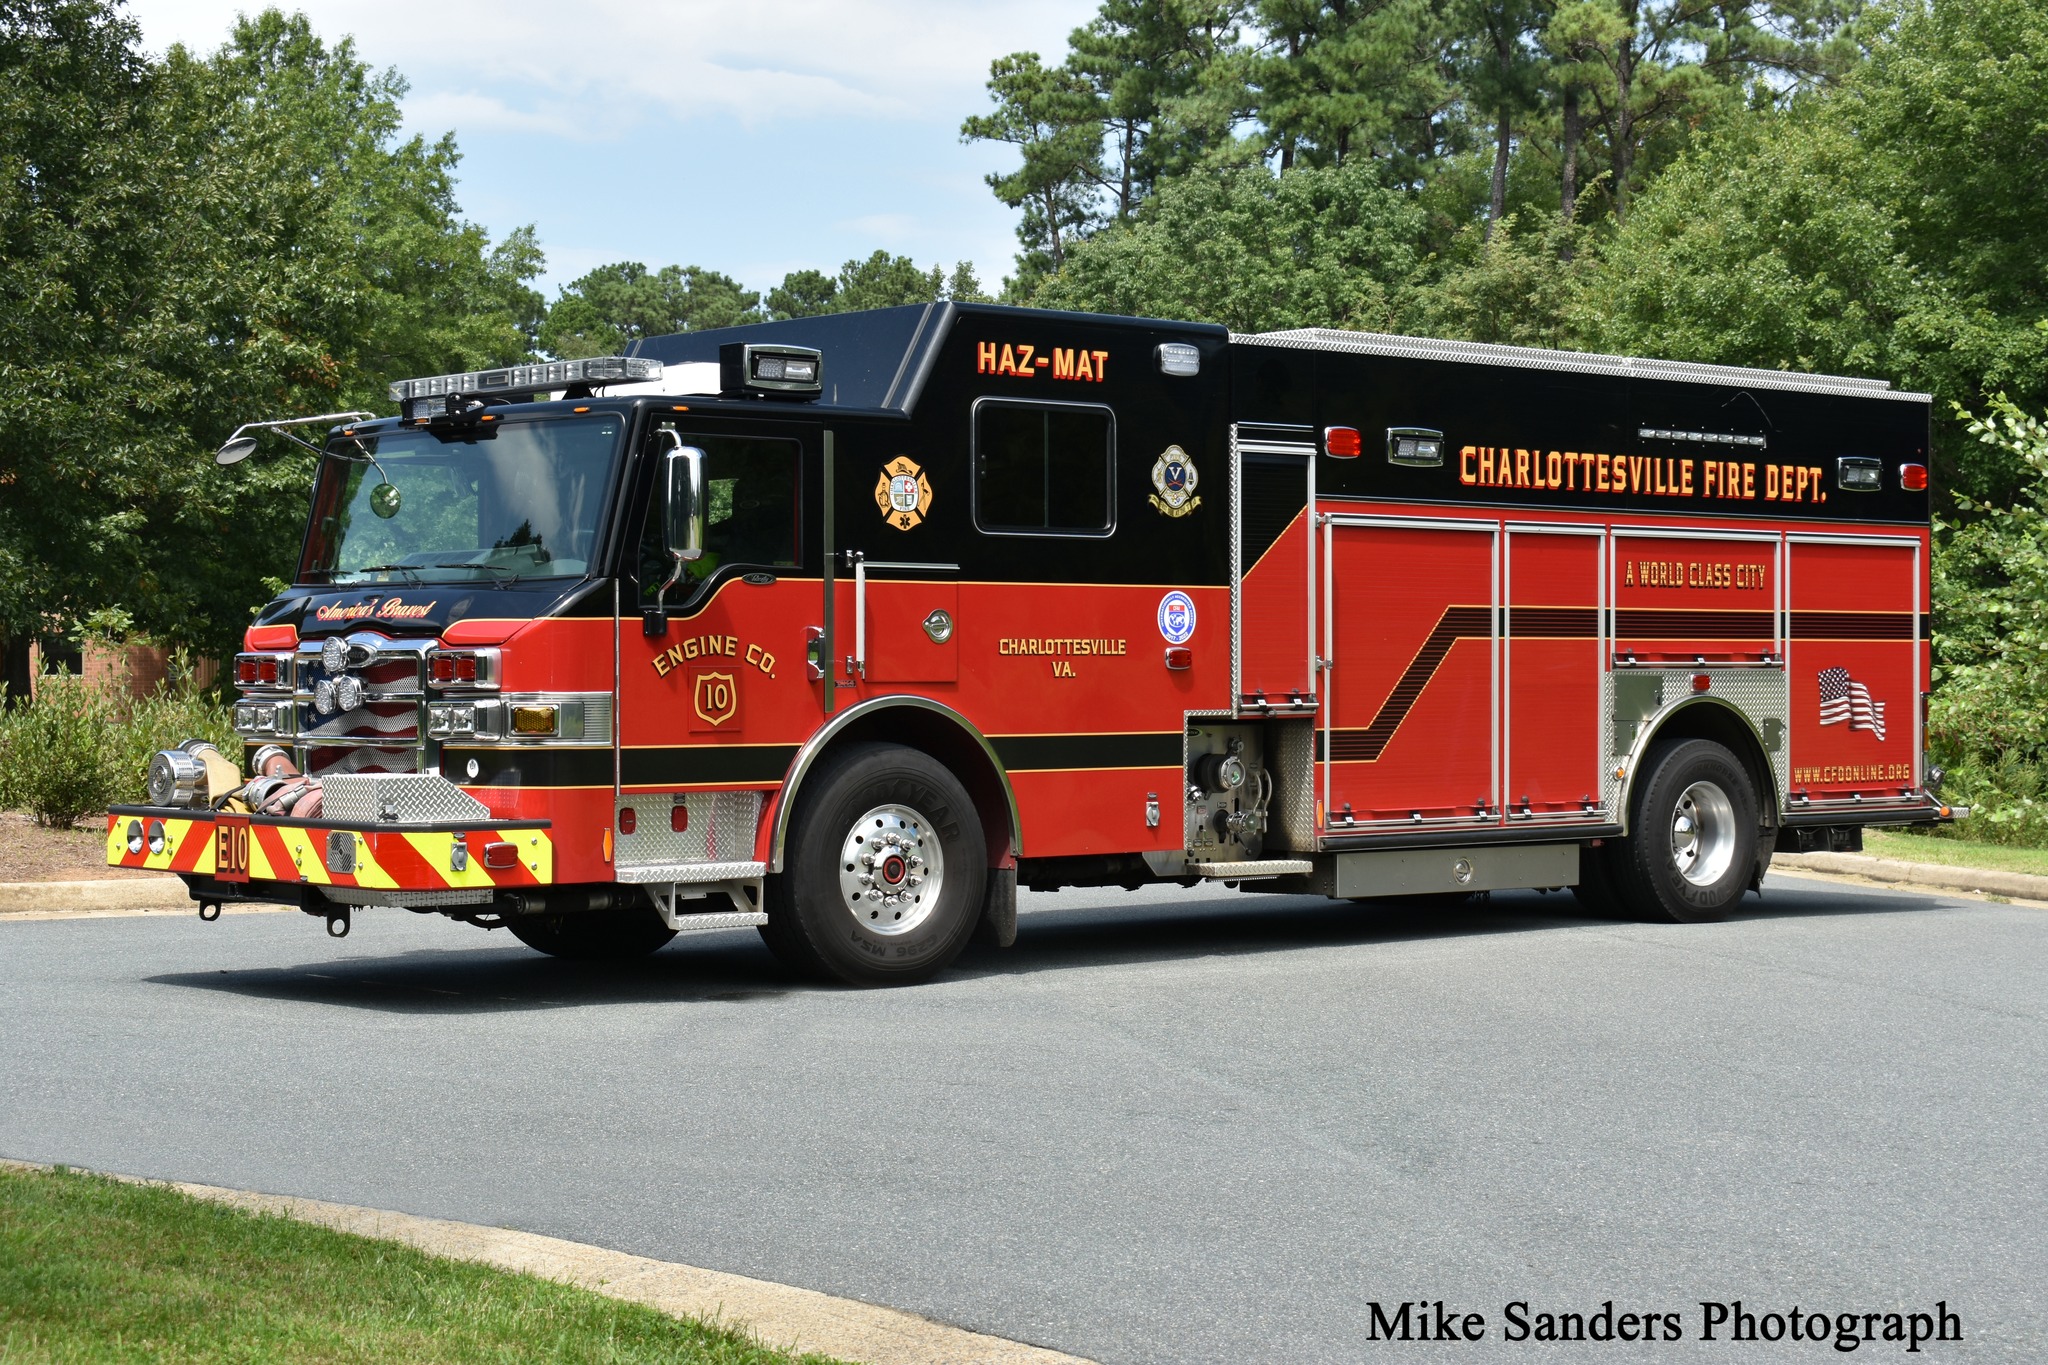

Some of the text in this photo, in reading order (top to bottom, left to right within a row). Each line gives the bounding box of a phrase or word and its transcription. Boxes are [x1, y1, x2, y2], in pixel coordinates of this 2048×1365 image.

[977, 341, 1109, 382] HAZ-MAT
[1459, 445, 1827, 503] CHARLOTTESVILLE FIRE DEPT.
[1625, 561, 1765, 590] A WORLD CLASS CITY
[317, 597, 437, 620] America's Bravest
[652, 635, 776, 680] ENGINE CO.
[999, 638, 1127, 656] CHARLOTTESVILLE
[1052, 661, 1077, 678] VA.
[706, 683, 728, 711] 10
[1794, 764, 1910, 784] WWW.CFDONLINE.ORG
[217, 825, 248, 874] E10
